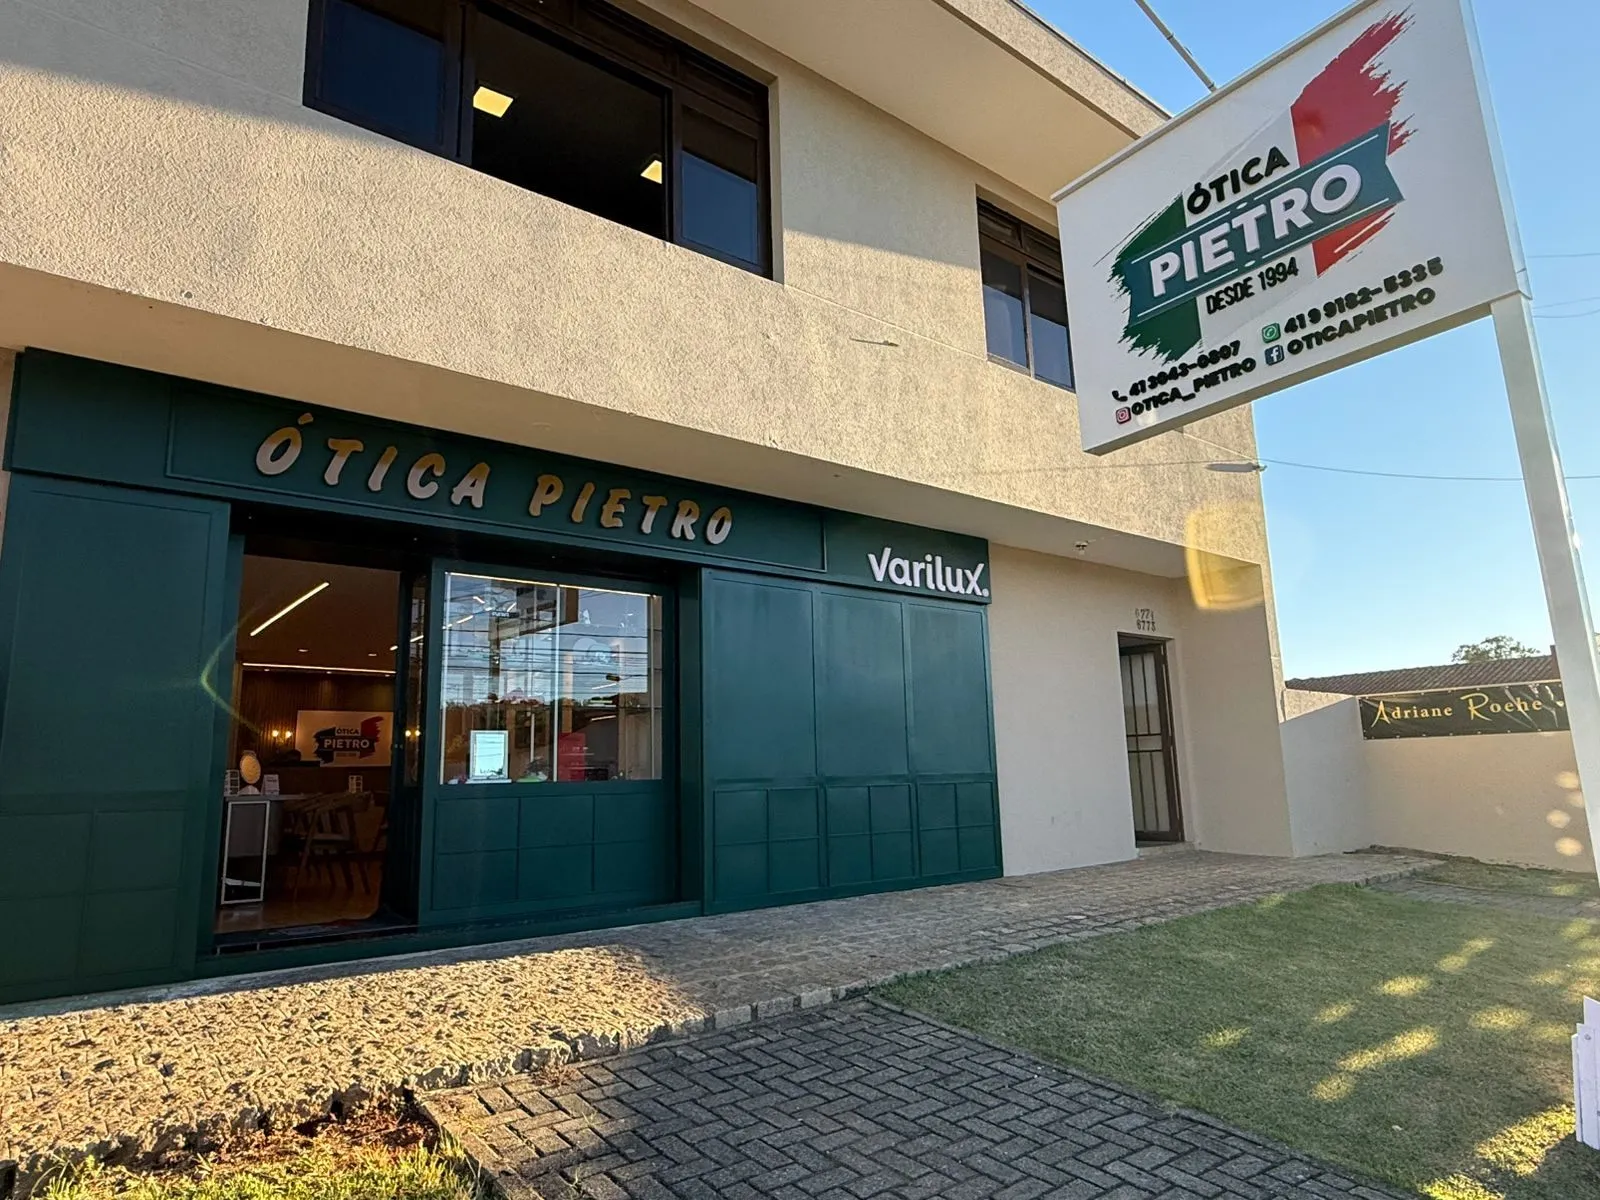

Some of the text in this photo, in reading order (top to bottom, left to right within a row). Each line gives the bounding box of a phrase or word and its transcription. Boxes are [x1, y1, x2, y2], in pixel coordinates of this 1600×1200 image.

[1187, 146, 1290, 214] ÓTICA
[1150, 164, 1361, 297] PIETRO
[1206, 256, 1299, 314] DESDE 1994
[1284, 313, 1306, 334] 41
[1287, 287, 1436, 355] OTICAPIETRO
[1129, 380, 1146, 396] 41
[1131, 357, 1257, 415] OTICA_PIETRO
[255, 412, 734, 545] ÓTICA PIETRO
[1371, 700, 1453, 728] Adriane
[324, 739, 369, 748] PIETRO
